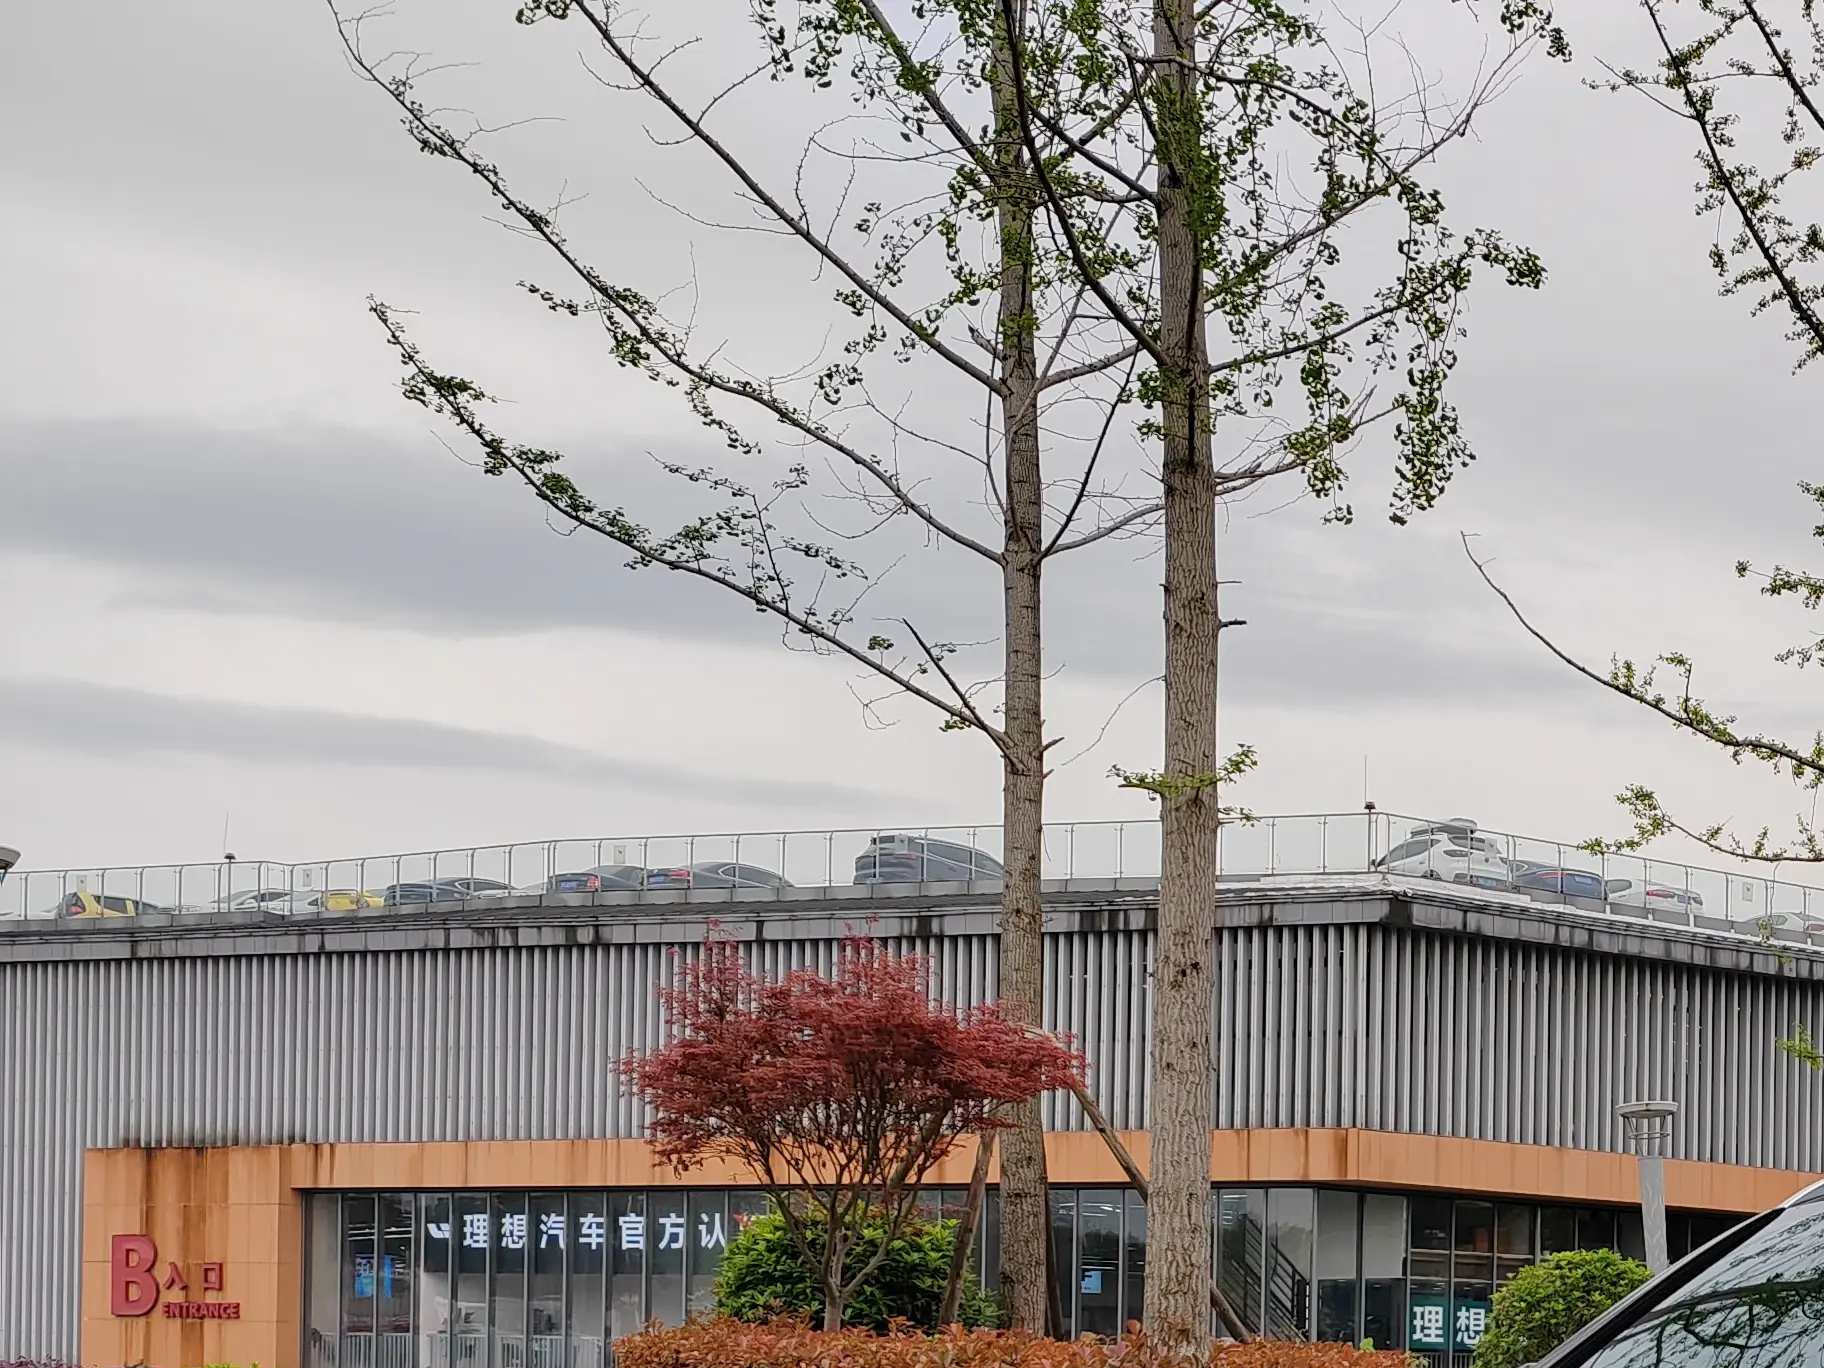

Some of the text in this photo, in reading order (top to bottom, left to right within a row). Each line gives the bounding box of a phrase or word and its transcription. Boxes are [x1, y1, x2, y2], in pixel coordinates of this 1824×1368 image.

[462, 1212, 767, 1250] 理想汽车官方认
[111, 1234, 159, 1316] B
[164, 1261, 223, 1291] 入口
[163, 1302, 240, 1319] ENTRANCE
[1412, 1305, 1486, 1345] 理想
